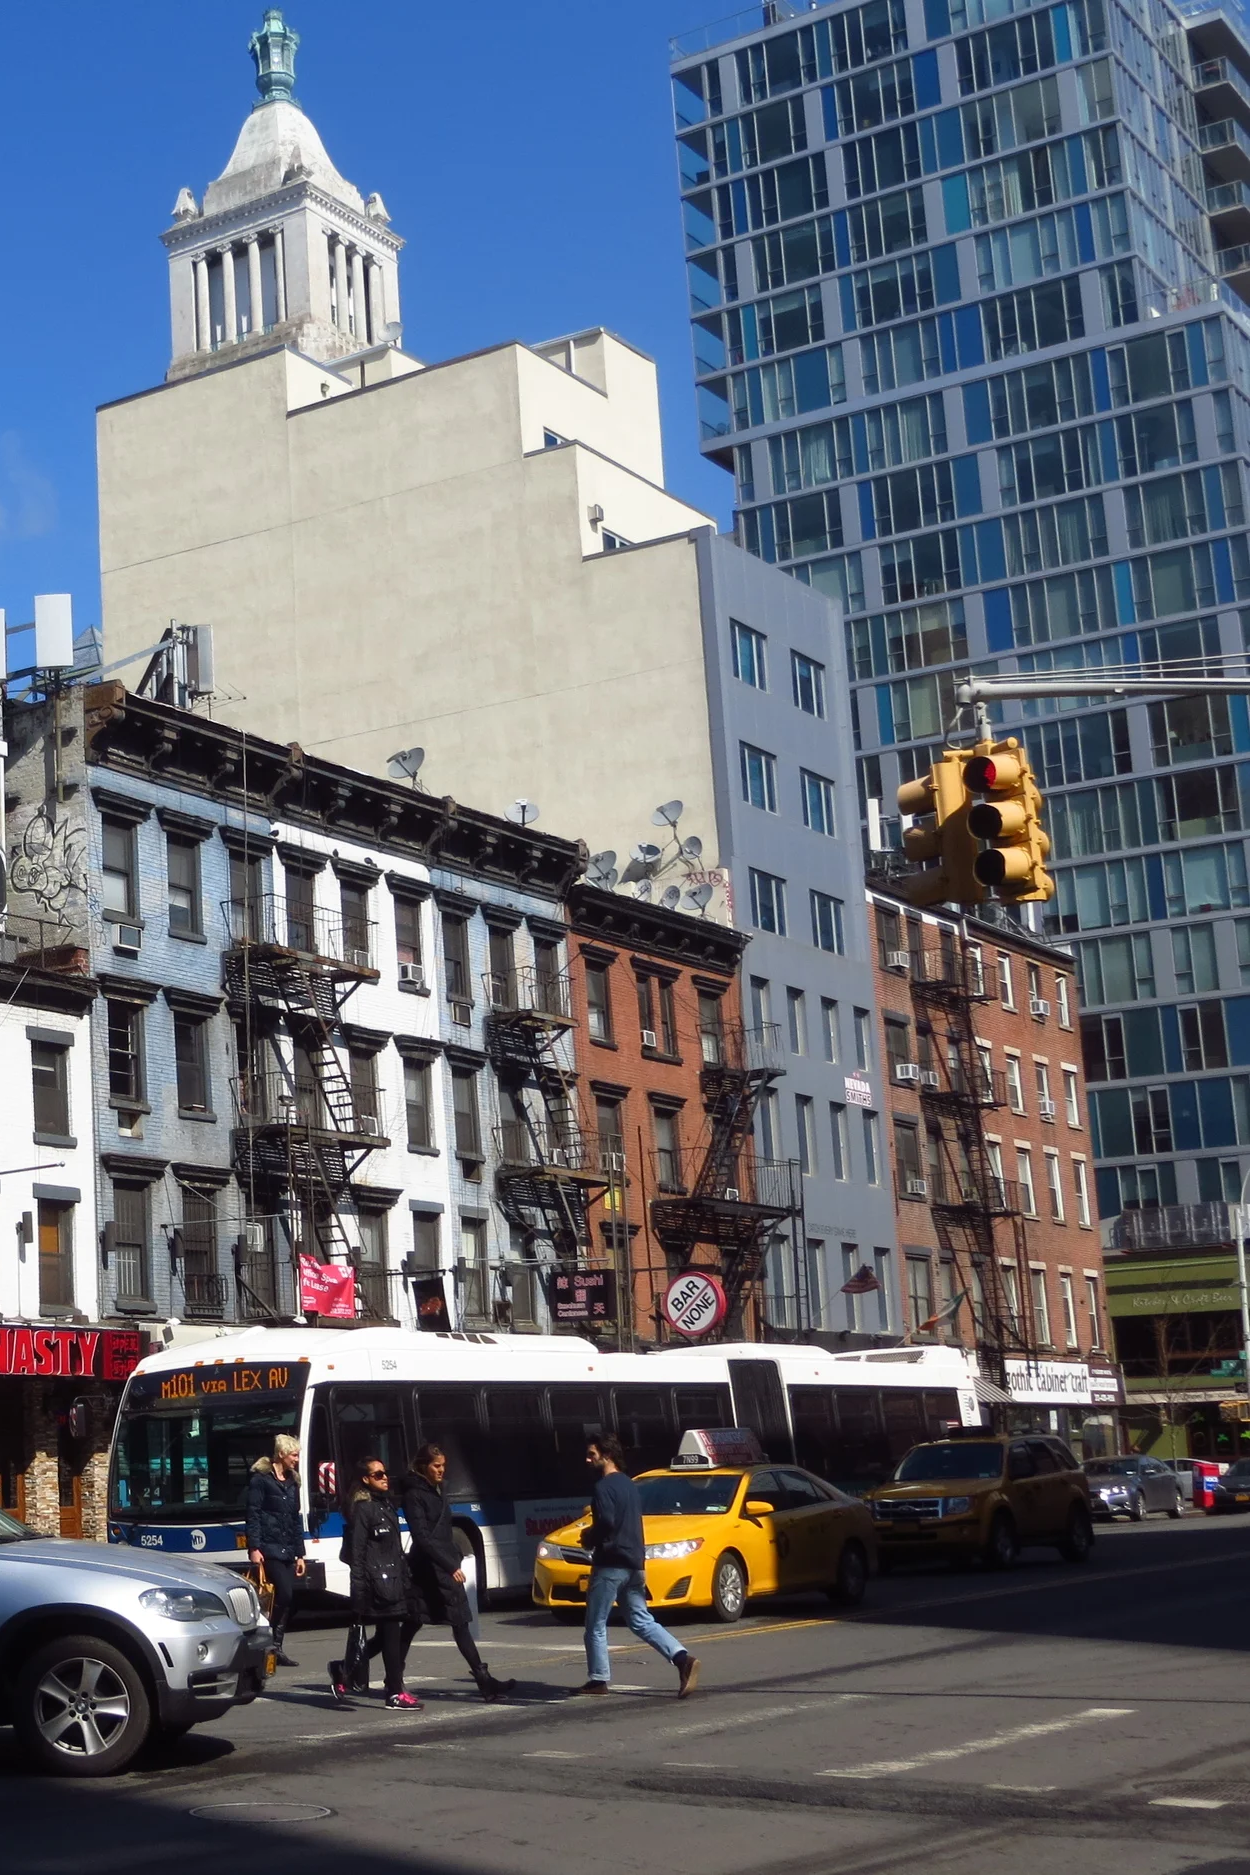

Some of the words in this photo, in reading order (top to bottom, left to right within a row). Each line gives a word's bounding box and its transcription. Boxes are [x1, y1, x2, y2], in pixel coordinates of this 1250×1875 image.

[671, 1280, 700, 1312] BAR
[681, 1292, 716, 1330] NONE
[162, 1372, 196, 1399] M101
[201, 1379, 227, 1393] VIA
[233, 1369, 262, 1392] LEX
[269, 1367, 288, 1389] AV
[141, 1535, 164, 1546] 5254
